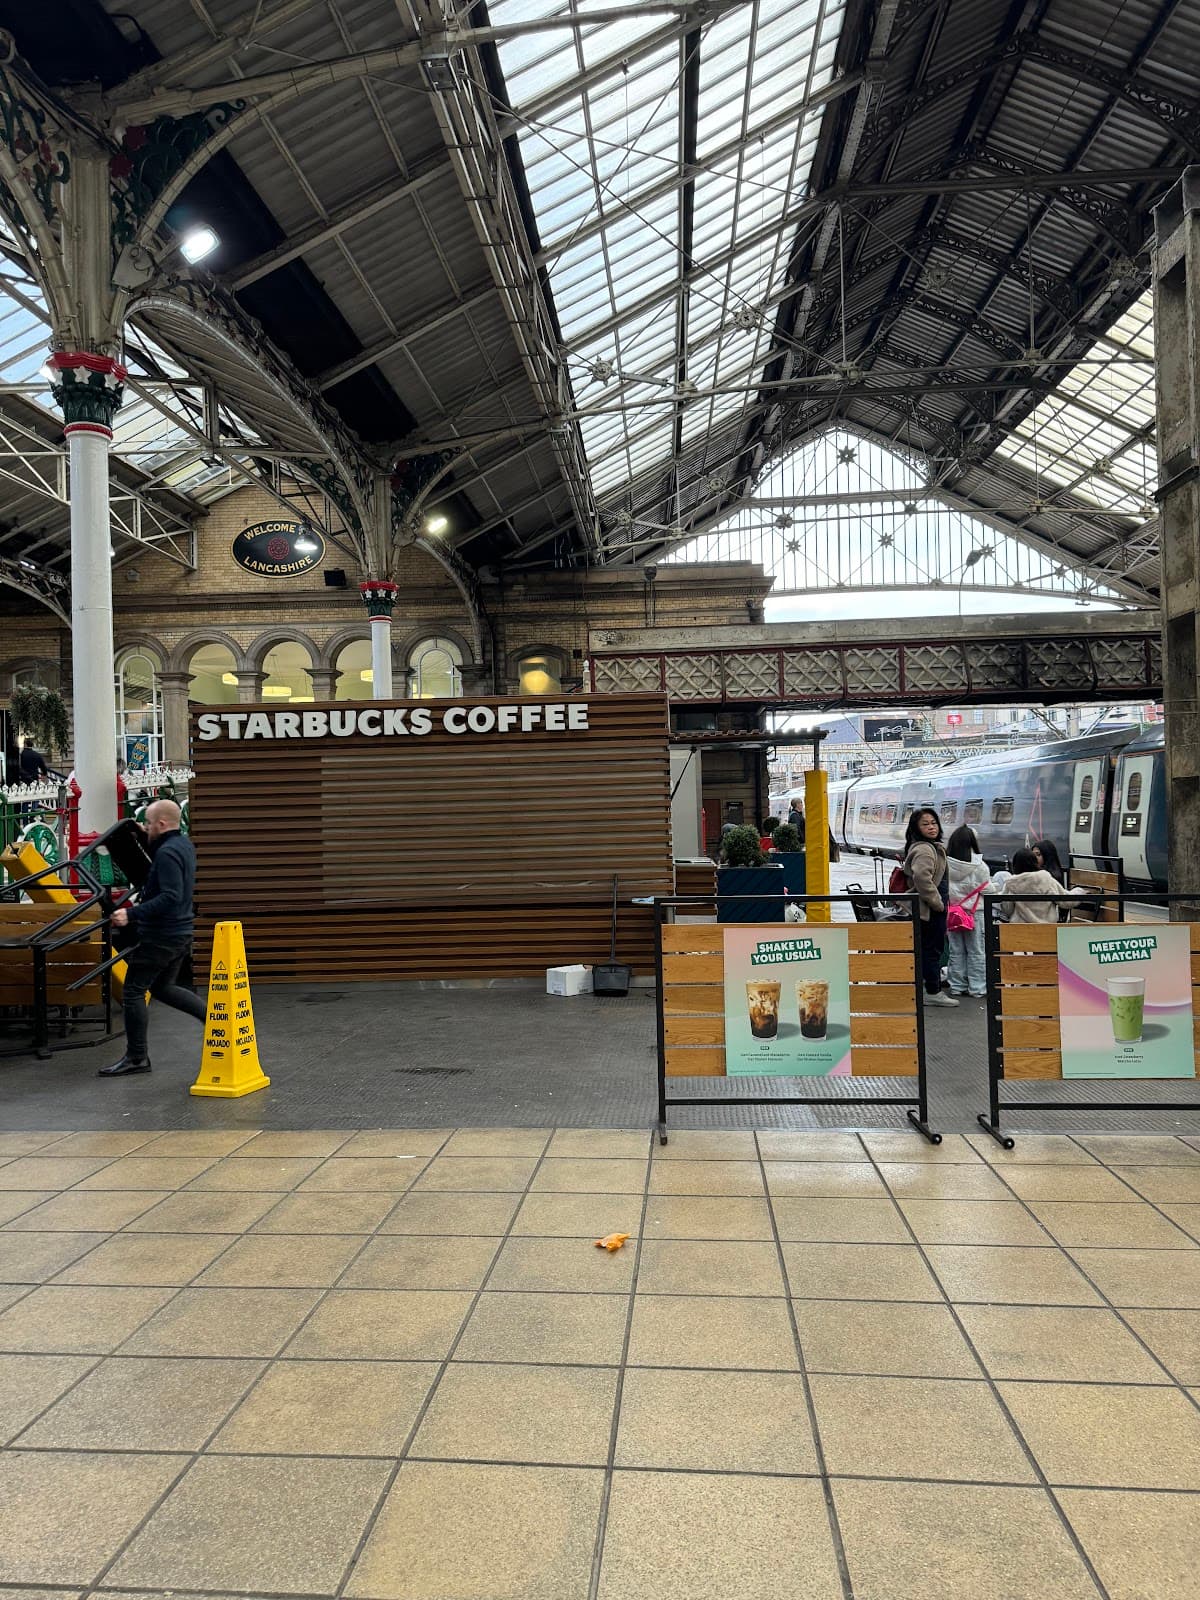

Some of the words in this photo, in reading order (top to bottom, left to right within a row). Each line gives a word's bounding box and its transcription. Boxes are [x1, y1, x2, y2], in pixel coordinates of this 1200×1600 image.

[243, 523, 296, 541] WELCOME
[244, 555, 313, 573] LANCASHIRE
[197, 707, 433, 741] STARBUCKS
[443, 703, 590, 734] COFFEE
[758, 941, 796, 953] SHAKE
[796, 939, 812, 950] UP
[1091, 941, 1122, 953] MEET
[1122, 938, 1156, 950] YOUR
[752, 952, 784, 964] YOUR
[784, 949, 820, 961] USUAL
[1100, 950, 1150, 963] MATCHA
[213, 1002, 226, 1011] WET
[209, 1012, 229, 1021] FLOOR
[236, 1010, 250, 1019] FLOOR
[212, 1029, 225, 1037] PISO
[239, 1026, 249, 1034] PISO
[206, 1039, 230, 1048] MOJADO
[236, 1035, 254, 1046] MOJADO
